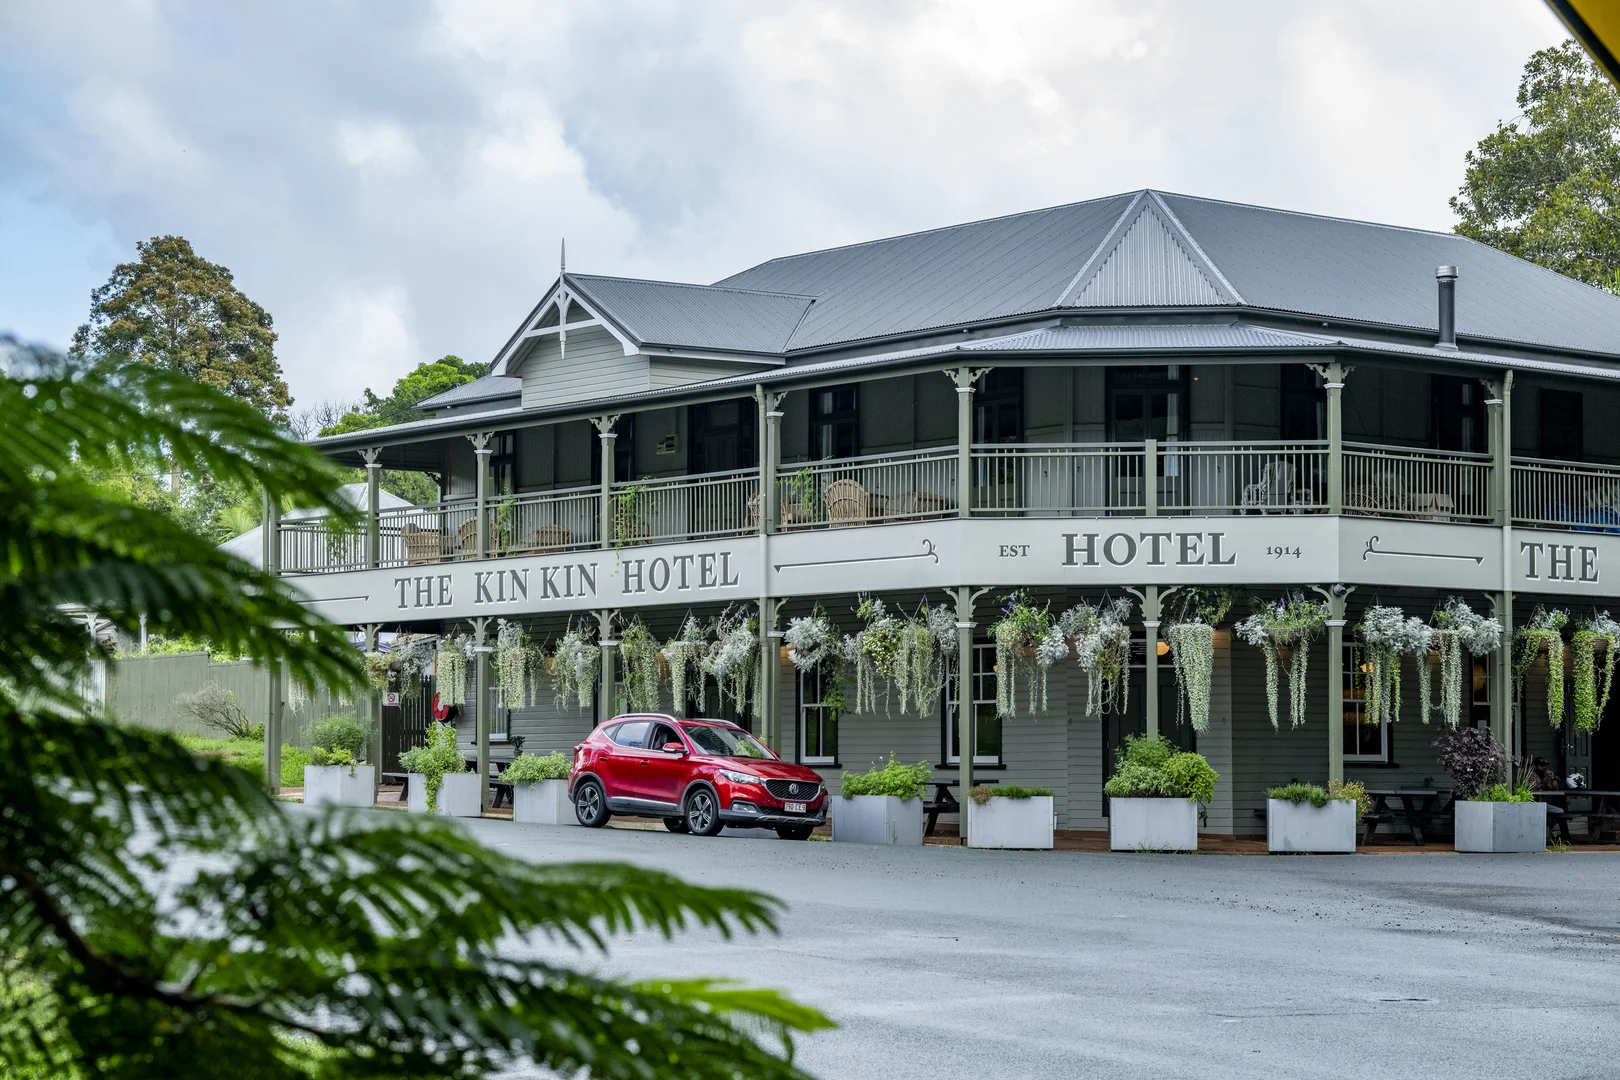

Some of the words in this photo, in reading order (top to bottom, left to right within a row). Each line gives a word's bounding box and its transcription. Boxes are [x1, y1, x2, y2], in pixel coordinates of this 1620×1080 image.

[998, 544, 1030, 558] EST
[1061, 531, 1237, 567] HOTEL
[1265, 545, 1303, 560] 1914
[1520, 540, 1600, 584] THE
[394, 574, 454, 610] THE
[474, 568, 531, 605] KIN
[540, 562, 599, 598] KIN
[621, 551, 741, 595] HOTEL
